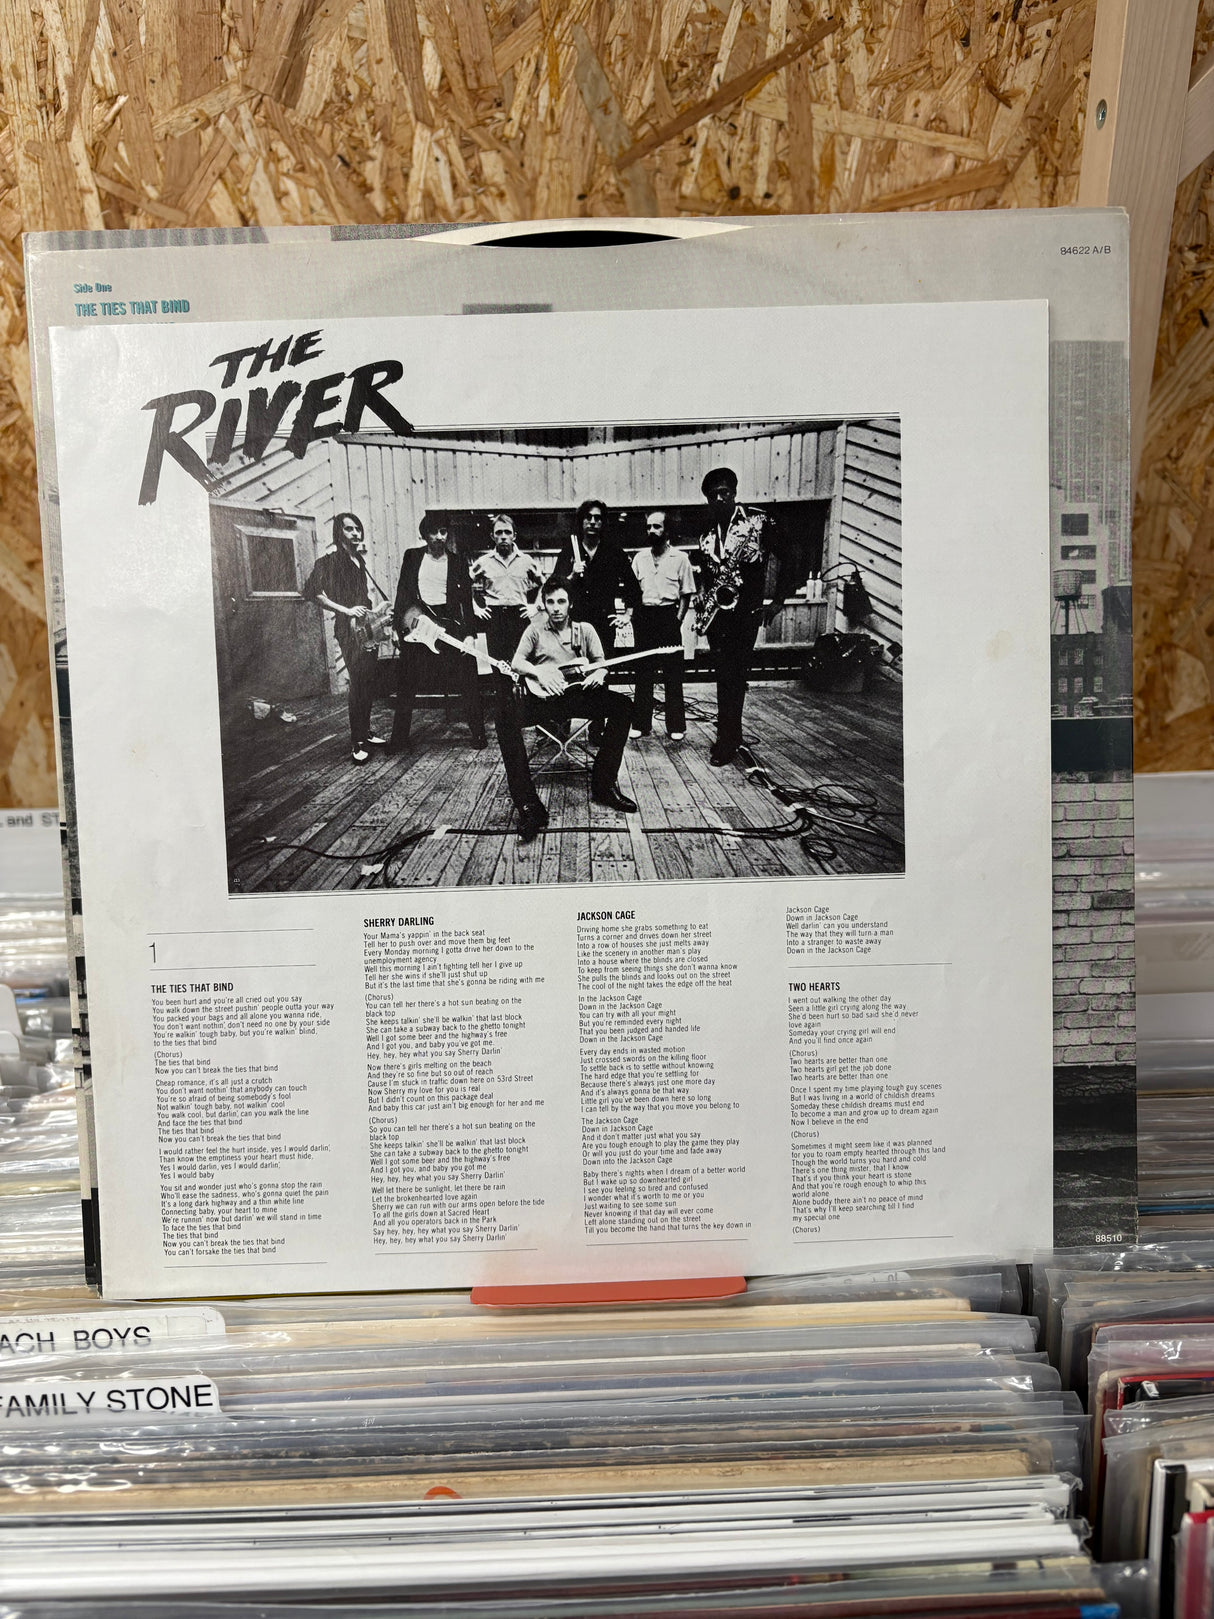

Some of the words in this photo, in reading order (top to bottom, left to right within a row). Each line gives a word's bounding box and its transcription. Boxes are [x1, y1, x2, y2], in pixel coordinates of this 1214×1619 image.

[1060, 247, 1090, 255] 84622
[1092, 246, 1111, 254] A/B
[73, 283, 93, 293] Side
[95, 282, 112, 292] One
[75, 303, 98, 316] THE
[100, 302, 126, 316] TIES
[129, 300, 158, 314] THAT
[161, 299, 190, 314] BIND
[208, 329, 324, 388] THE
[138, 360, 416, 506] RIVER
[7, 812, 33, 827] and
[813, 905, 830, 914] Cage
[577, 911, 612, 921] JACKSON
[615, 911, 635, 920] CAGE
[363, 918, 395, 927] SHERRY
[398, 917, 434, 927] DARLING
[398, 939, 416, 948] push
[486, 936, 496, 945] big
[364, 955, 413, 966] unemployment
[151, 984, 167, 993] THE
[169, 984, 187, 993] TIES
[190, 983, 210, 992] THAT
[213, 982, 234, 992] BIND
[788, 983, 806, 991] TWO
[809, 982, 841, 991] HEARTS
[365, 992, 394, 1002] (Chorus)
[261, 1003, 284, 1012] people
[384, 1009, 396, 1018] top
[606, 1010, 615, 1019] try
[658, 1008, 676, 1018] might
[804, 1020, 822, 1029] again
[154, 1050, 183, 1059] (Chorus)
[670, 1053, 690, 1062] killing
[789, 1048, 818, 1057] (Chorus)
[194, 1102, 213, 1111] tough
[369, 1116, 398, 1126] (Chorus)
[791, 1130, 820, 1139] (Chorus)
[208, 1153, 242, 1163] emptiness
[657, 1156, 673, 1165] Cage
[161, 1207, 198, 1217] Connecting
[803, 1212, 827, 1222] special
[618, 1216, 646, 1226] standing
[792, 1225, 821, 1235] (Chorus)
[1095, 1234, 1122, 1242] 88510
[74, 1326, 151, 1350] BOYS
[107, 1384, 213, 1412] STONE
